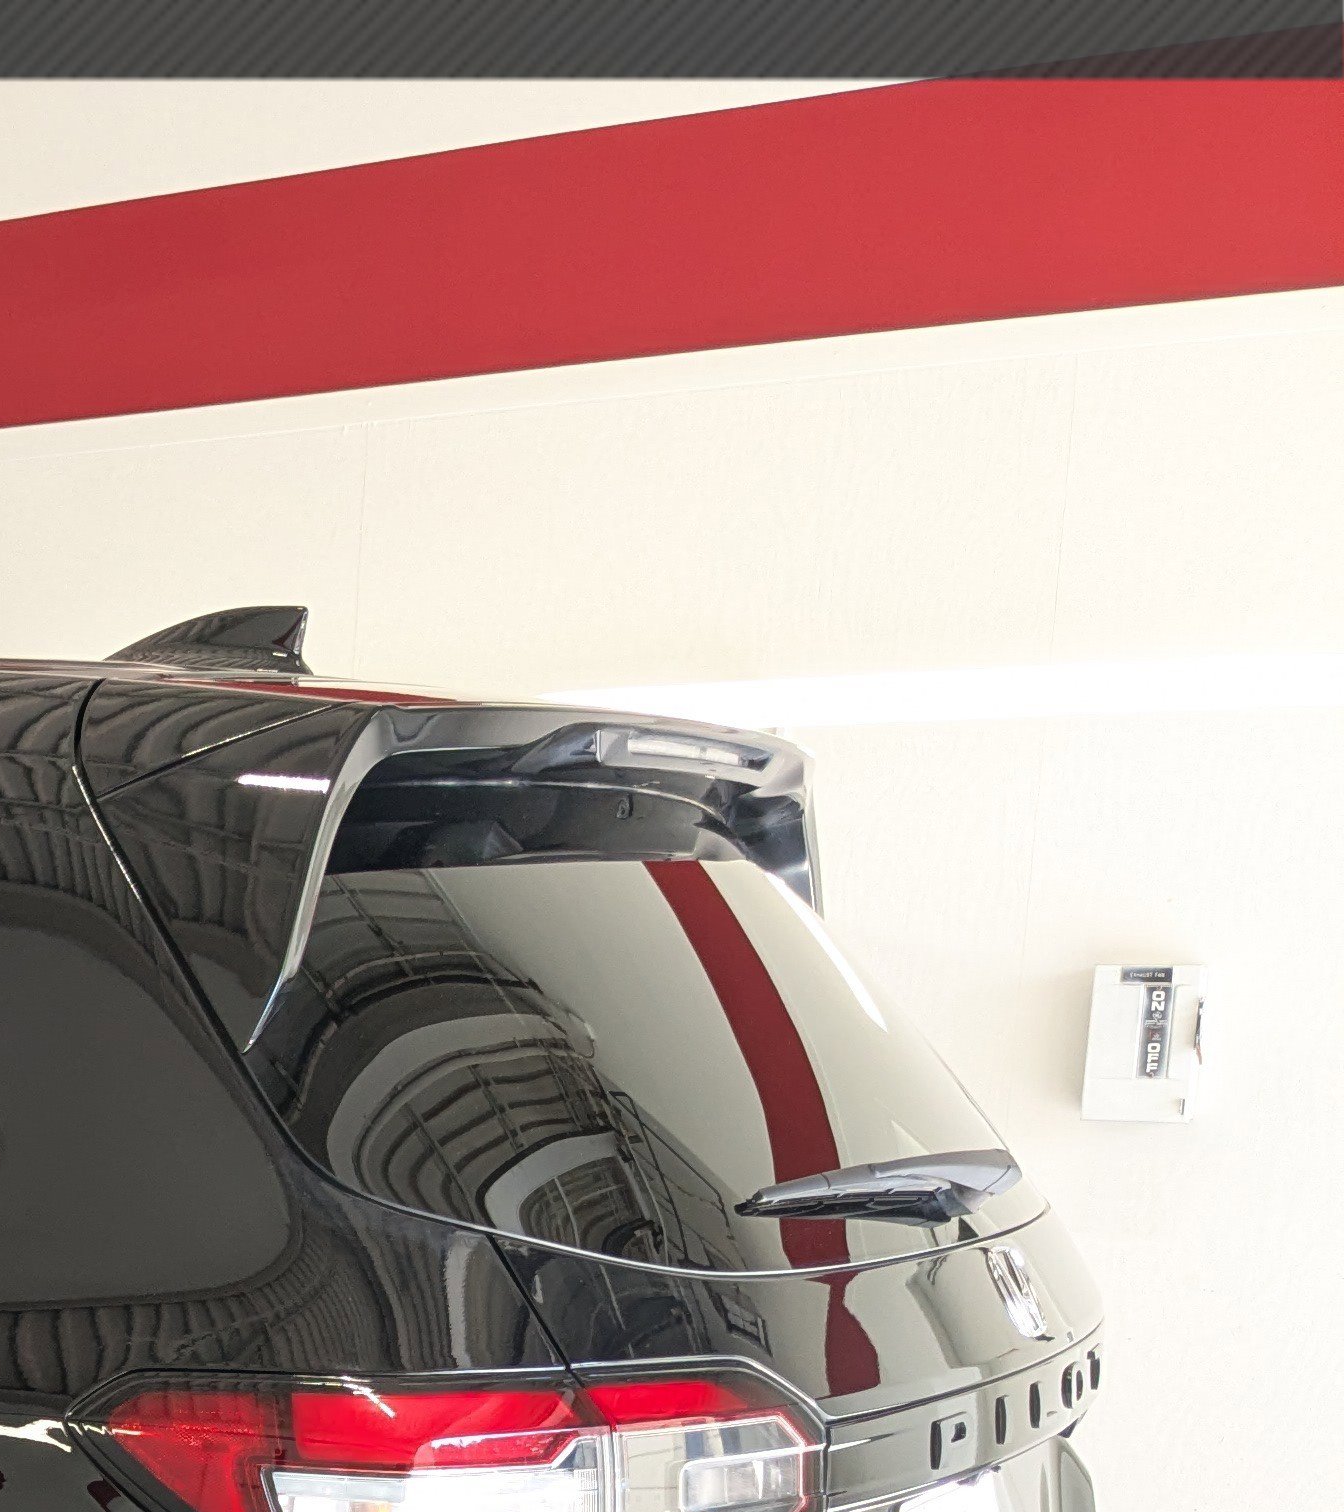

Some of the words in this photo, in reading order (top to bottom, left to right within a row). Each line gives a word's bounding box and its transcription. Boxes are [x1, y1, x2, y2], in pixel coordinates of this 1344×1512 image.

[1151, 990, 1166, 1011] ON
[1145, 1042, 1161, 1073] OFF
[930, 1349, 1102, 1470] PILOT
